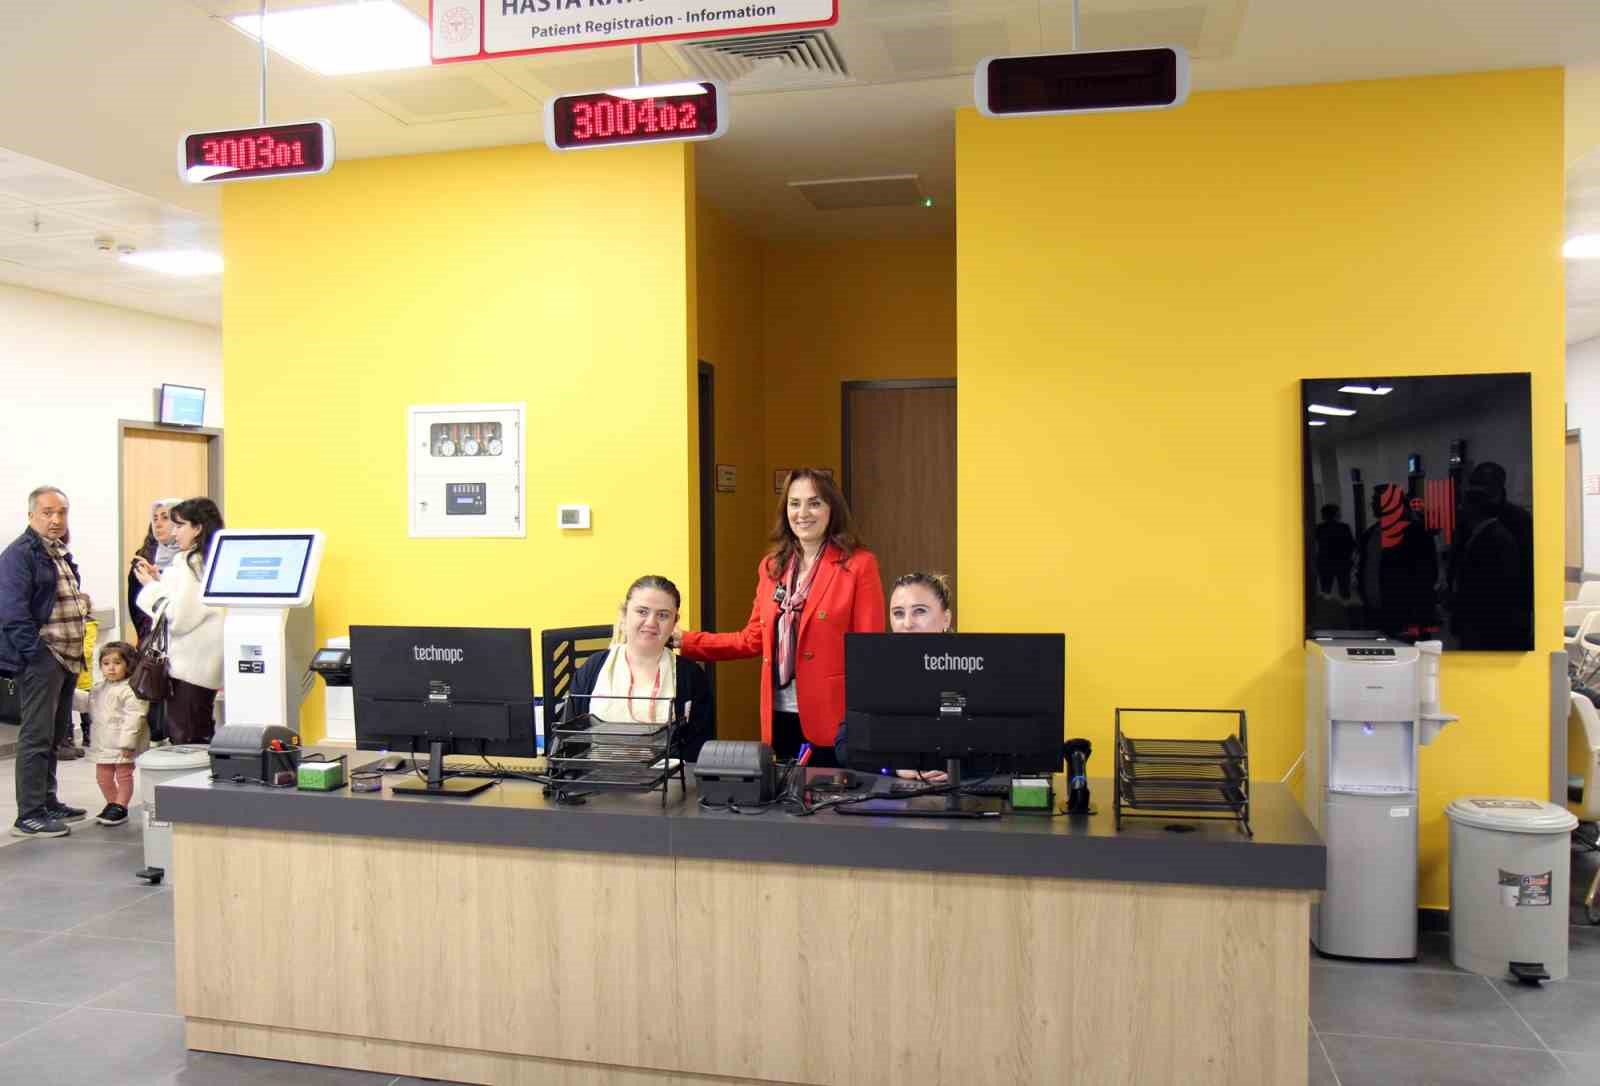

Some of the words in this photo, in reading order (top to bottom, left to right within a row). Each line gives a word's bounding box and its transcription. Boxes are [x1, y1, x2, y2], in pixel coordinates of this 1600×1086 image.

[531, 23, 581, 39] Patient
[585, 14, 673, 34] Registration
[686, 4, 776, 23] Information
[413, 644, 464, 664] technopc
[923, 652, 984, 674] technopc
